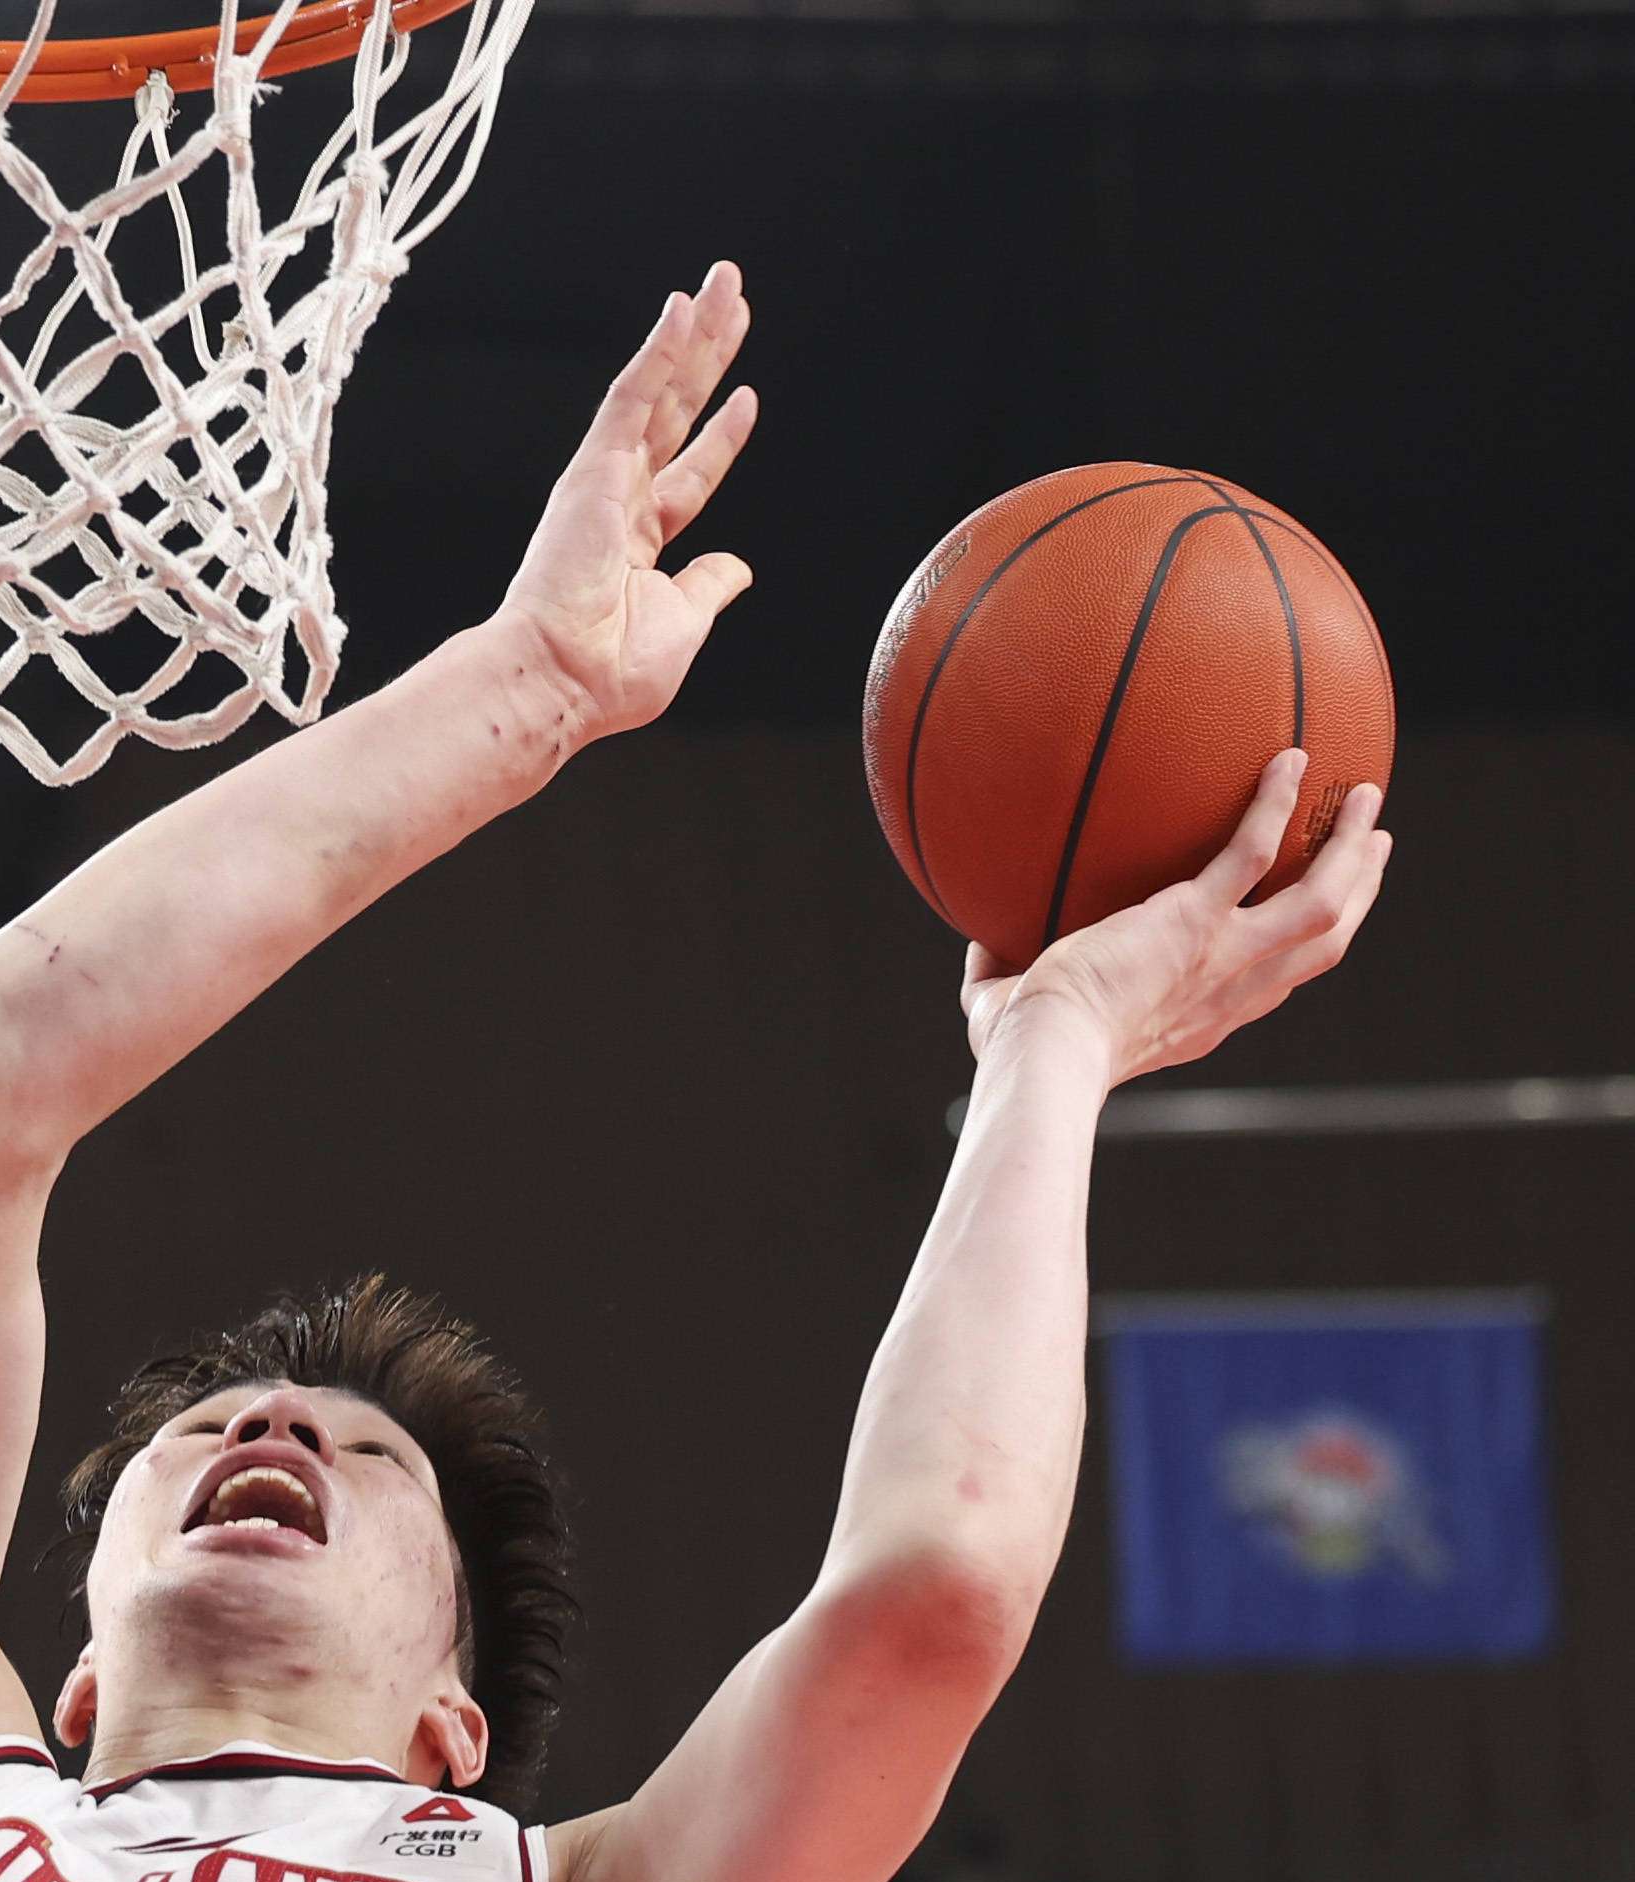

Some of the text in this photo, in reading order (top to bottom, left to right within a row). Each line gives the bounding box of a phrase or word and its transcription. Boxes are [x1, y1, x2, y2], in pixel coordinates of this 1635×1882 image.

[379, 1829, 483, 1846] 广发银行
[395, 1844, 457, 1857] CGB
